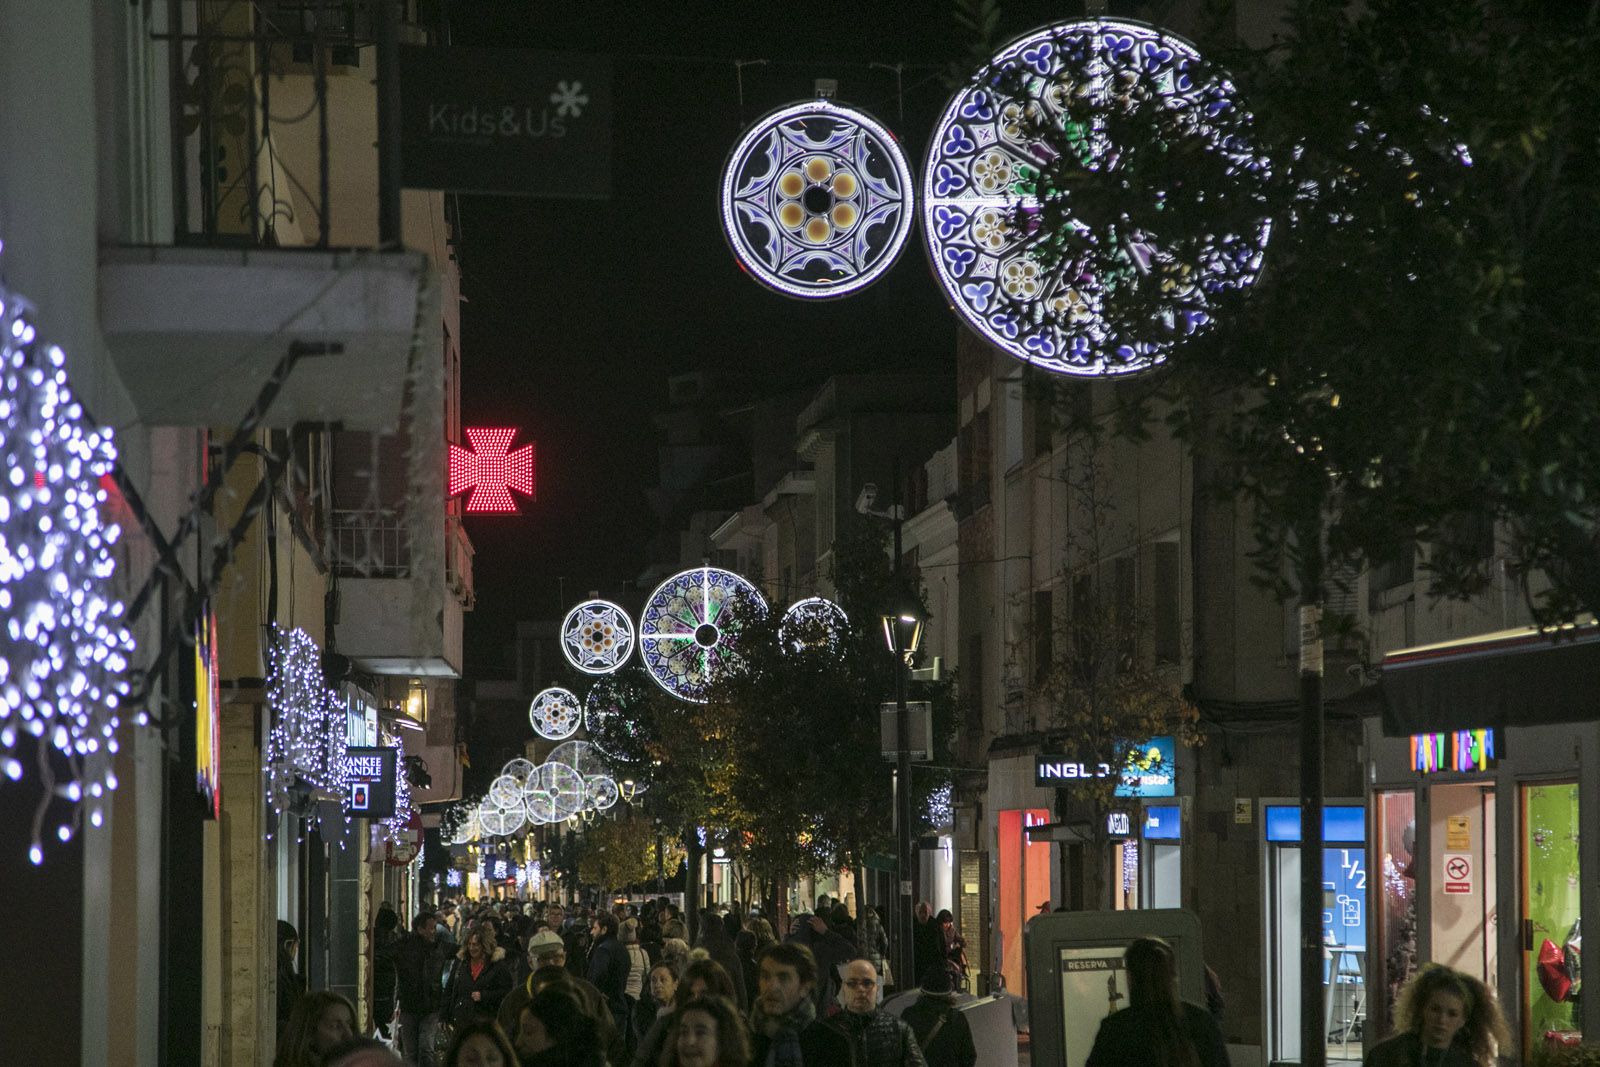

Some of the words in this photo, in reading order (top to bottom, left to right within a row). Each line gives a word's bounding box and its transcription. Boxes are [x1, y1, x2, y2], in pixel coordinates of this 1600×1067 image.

[429, 104, 567, 137] Kids&Us
[343, 756, 382, 767] YANKEE
[1040, 763, 1112, 778] INGLO
[1068, 961, 1108, 970] RESERVA
